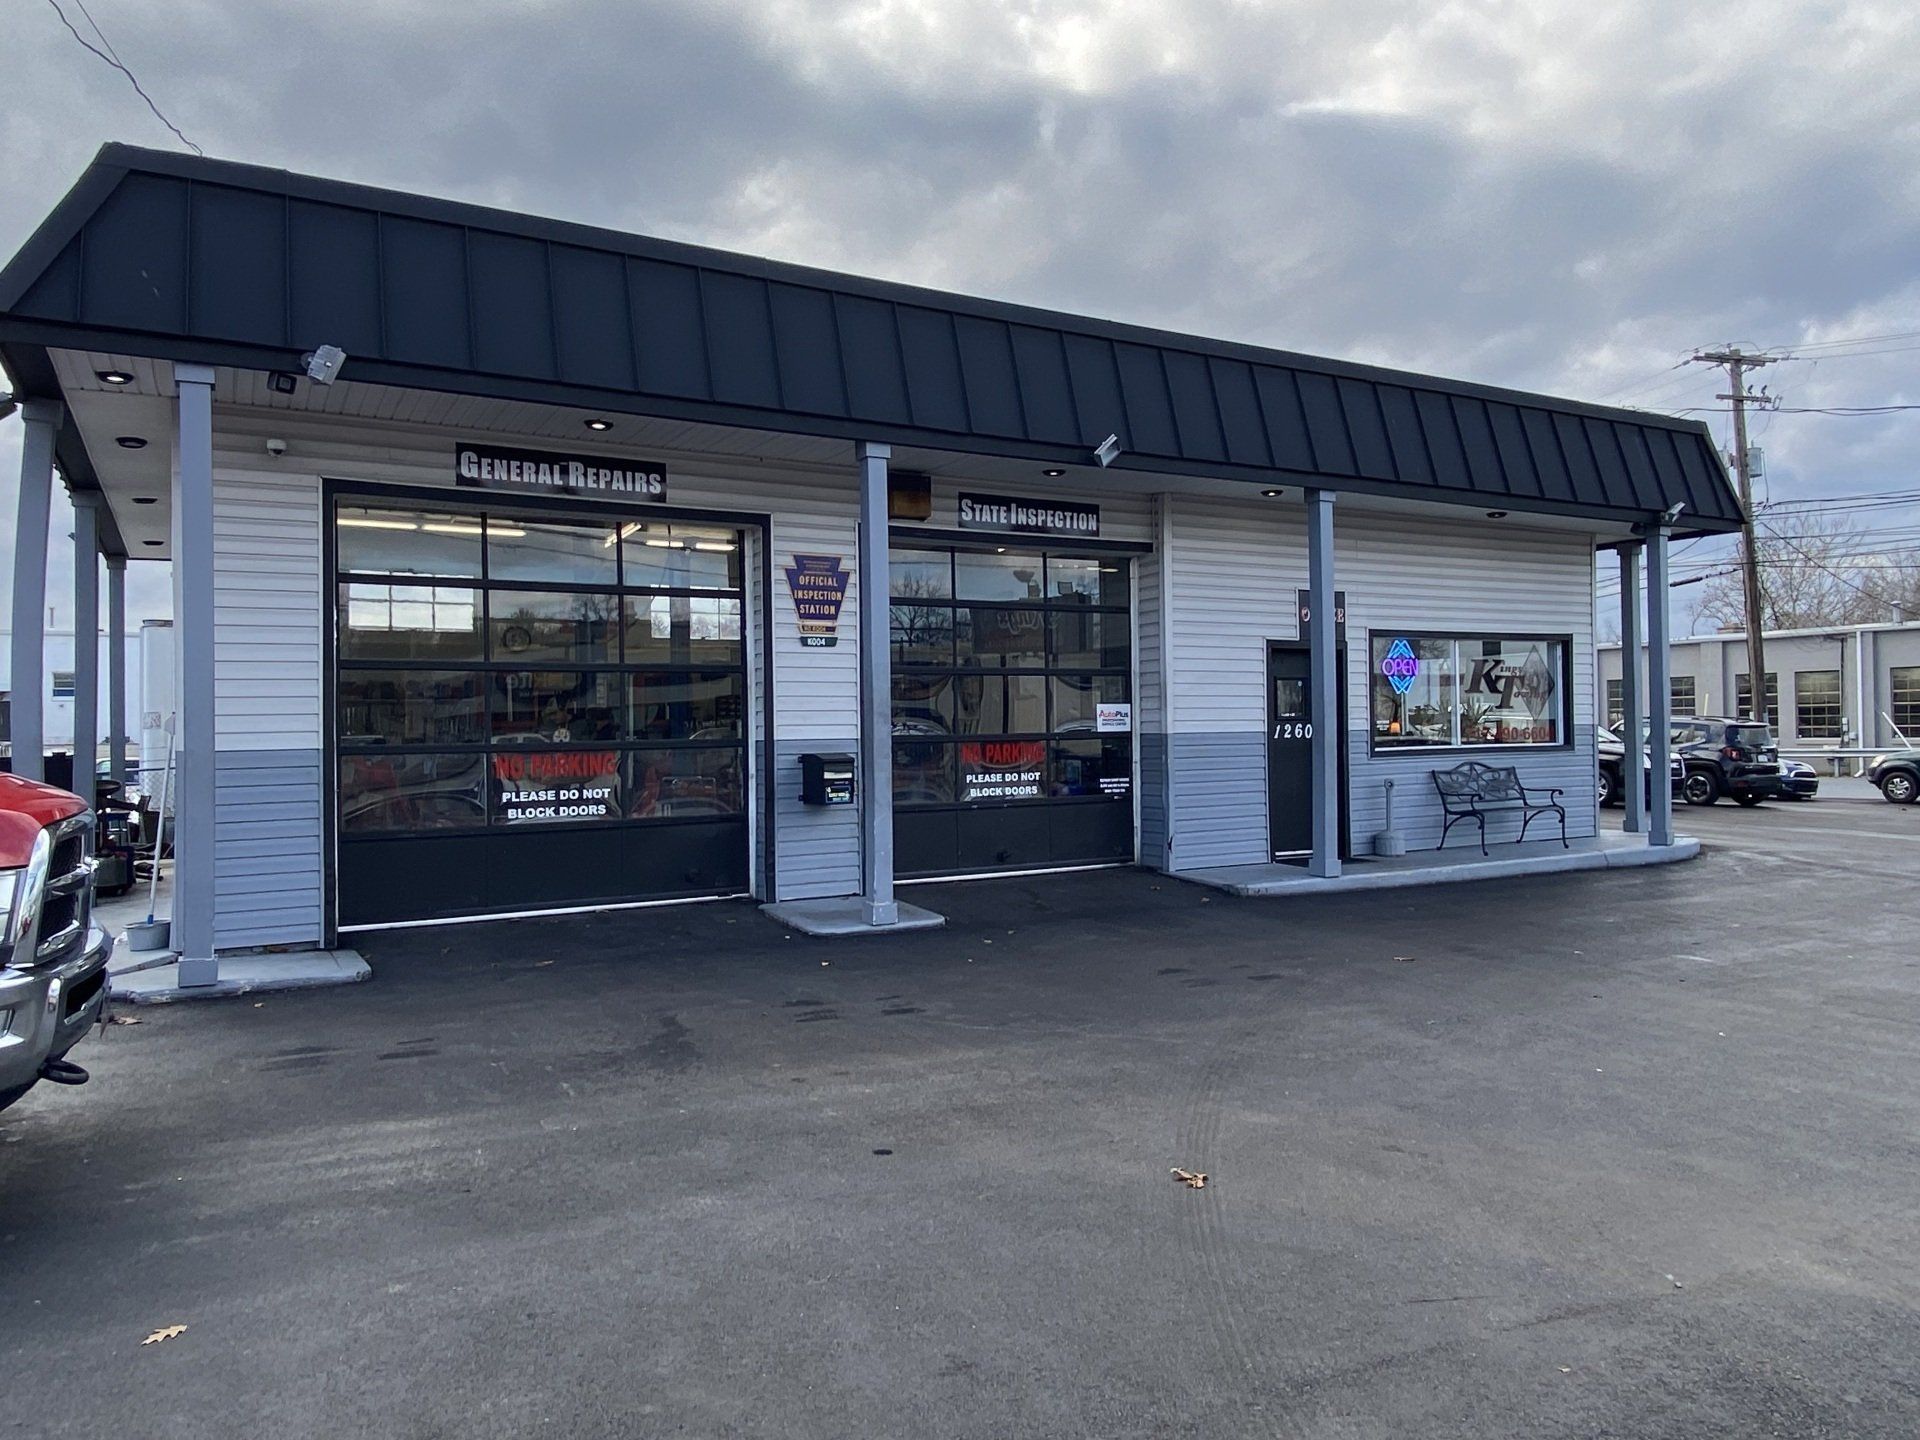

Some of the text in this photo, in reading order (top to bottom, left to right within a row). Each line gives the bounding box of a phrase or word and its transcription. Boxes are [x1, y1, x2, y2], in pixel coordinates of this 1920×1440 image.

[460, 451, 662, 495] GENERAL REPAIRS
[961, 498, 1097, 531] STATE INSPECTION
[799, 575, 838, 587] OFFICIAL
[794, 589, 842, 601] INSPECTION
[800, 604, 836, 615] STATION
[1382, 658, 1419, 676] OPEN
[1273, 723, 1313, 739] 1260
[986, 743, 1045, 764] PARKING
[494, 752, 617, 781] NO PARKING
[966, 771, 1041, 784] PLEASE DO NOT
[502, 788, 611, 803] PLEASE DO NOT
[970, 785, 1038, 797] BLOCK DOORS
[507, 804, 607, 819] BLOCK DOORS
